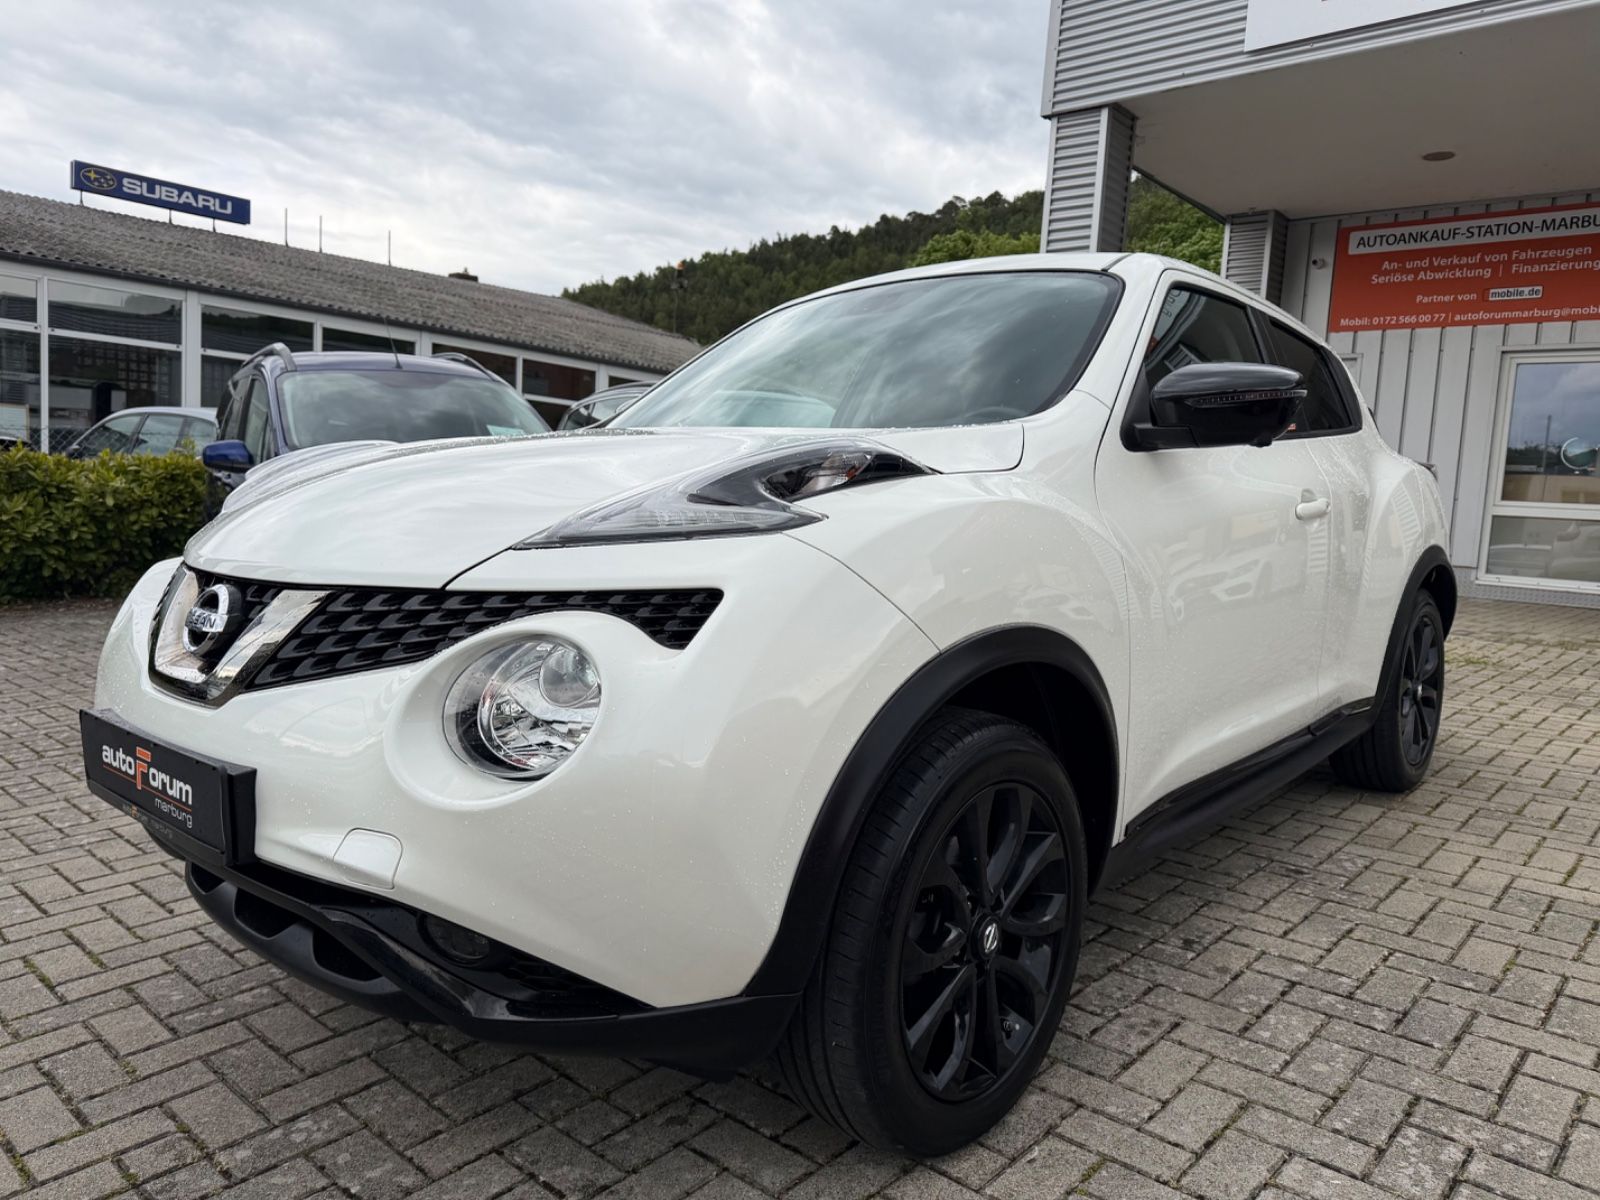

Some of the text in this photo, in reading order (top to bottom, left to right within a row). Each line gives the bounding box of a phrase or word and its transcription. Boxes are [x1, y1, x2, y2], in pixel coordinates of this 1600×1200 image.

[122, 177, 232, 214] SUBARU
[1382, 246, 1592, 271] An- und Verkauf von Fahrzeugen
[1371, 259, 1600, 285] Seriöse Abwicklung Finanzierung
[1416, 287, 1541, 304] Partner von mobile.de
[1340, 317, 1370, 327] Mobil:
[1372, 315, 1396, 325] 0172
[1400, 314, 1417, 324] 566
[1418, 313, 1431, 323] 00
[1432, 313, 1446, 322] 77
[155, 798, 193, 829] marburg
